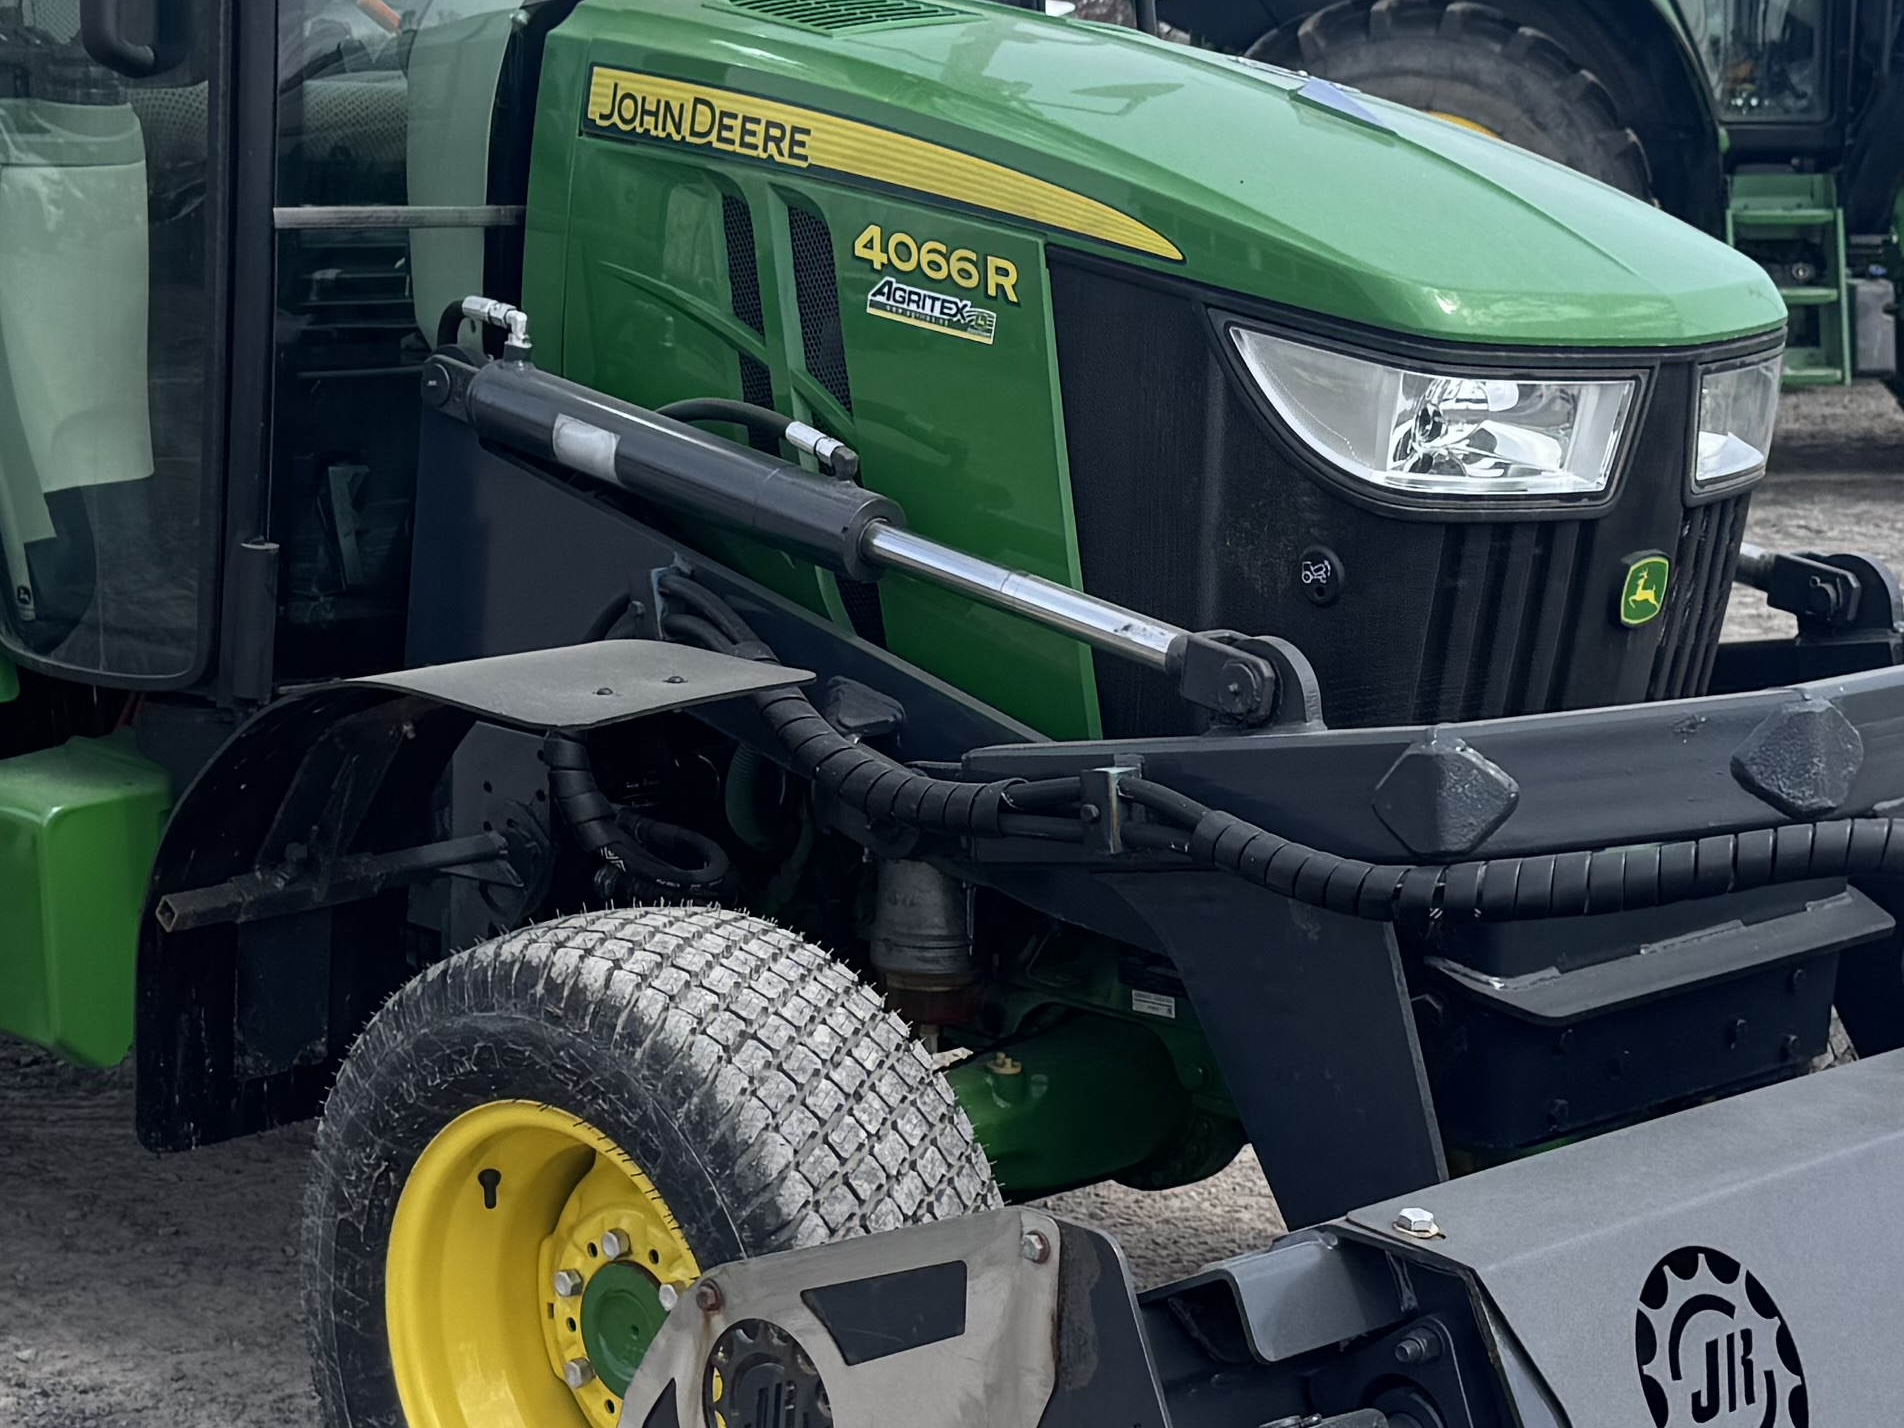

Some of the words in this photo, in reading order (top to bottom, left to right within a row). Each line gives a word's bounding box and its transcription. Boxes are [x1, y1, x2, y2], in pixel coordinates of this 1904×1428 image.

[597, 82, 684, 137] JOHN
[688, 96, 811, 163] DEERE
[871, 279, 969, 322] AGRITEX
